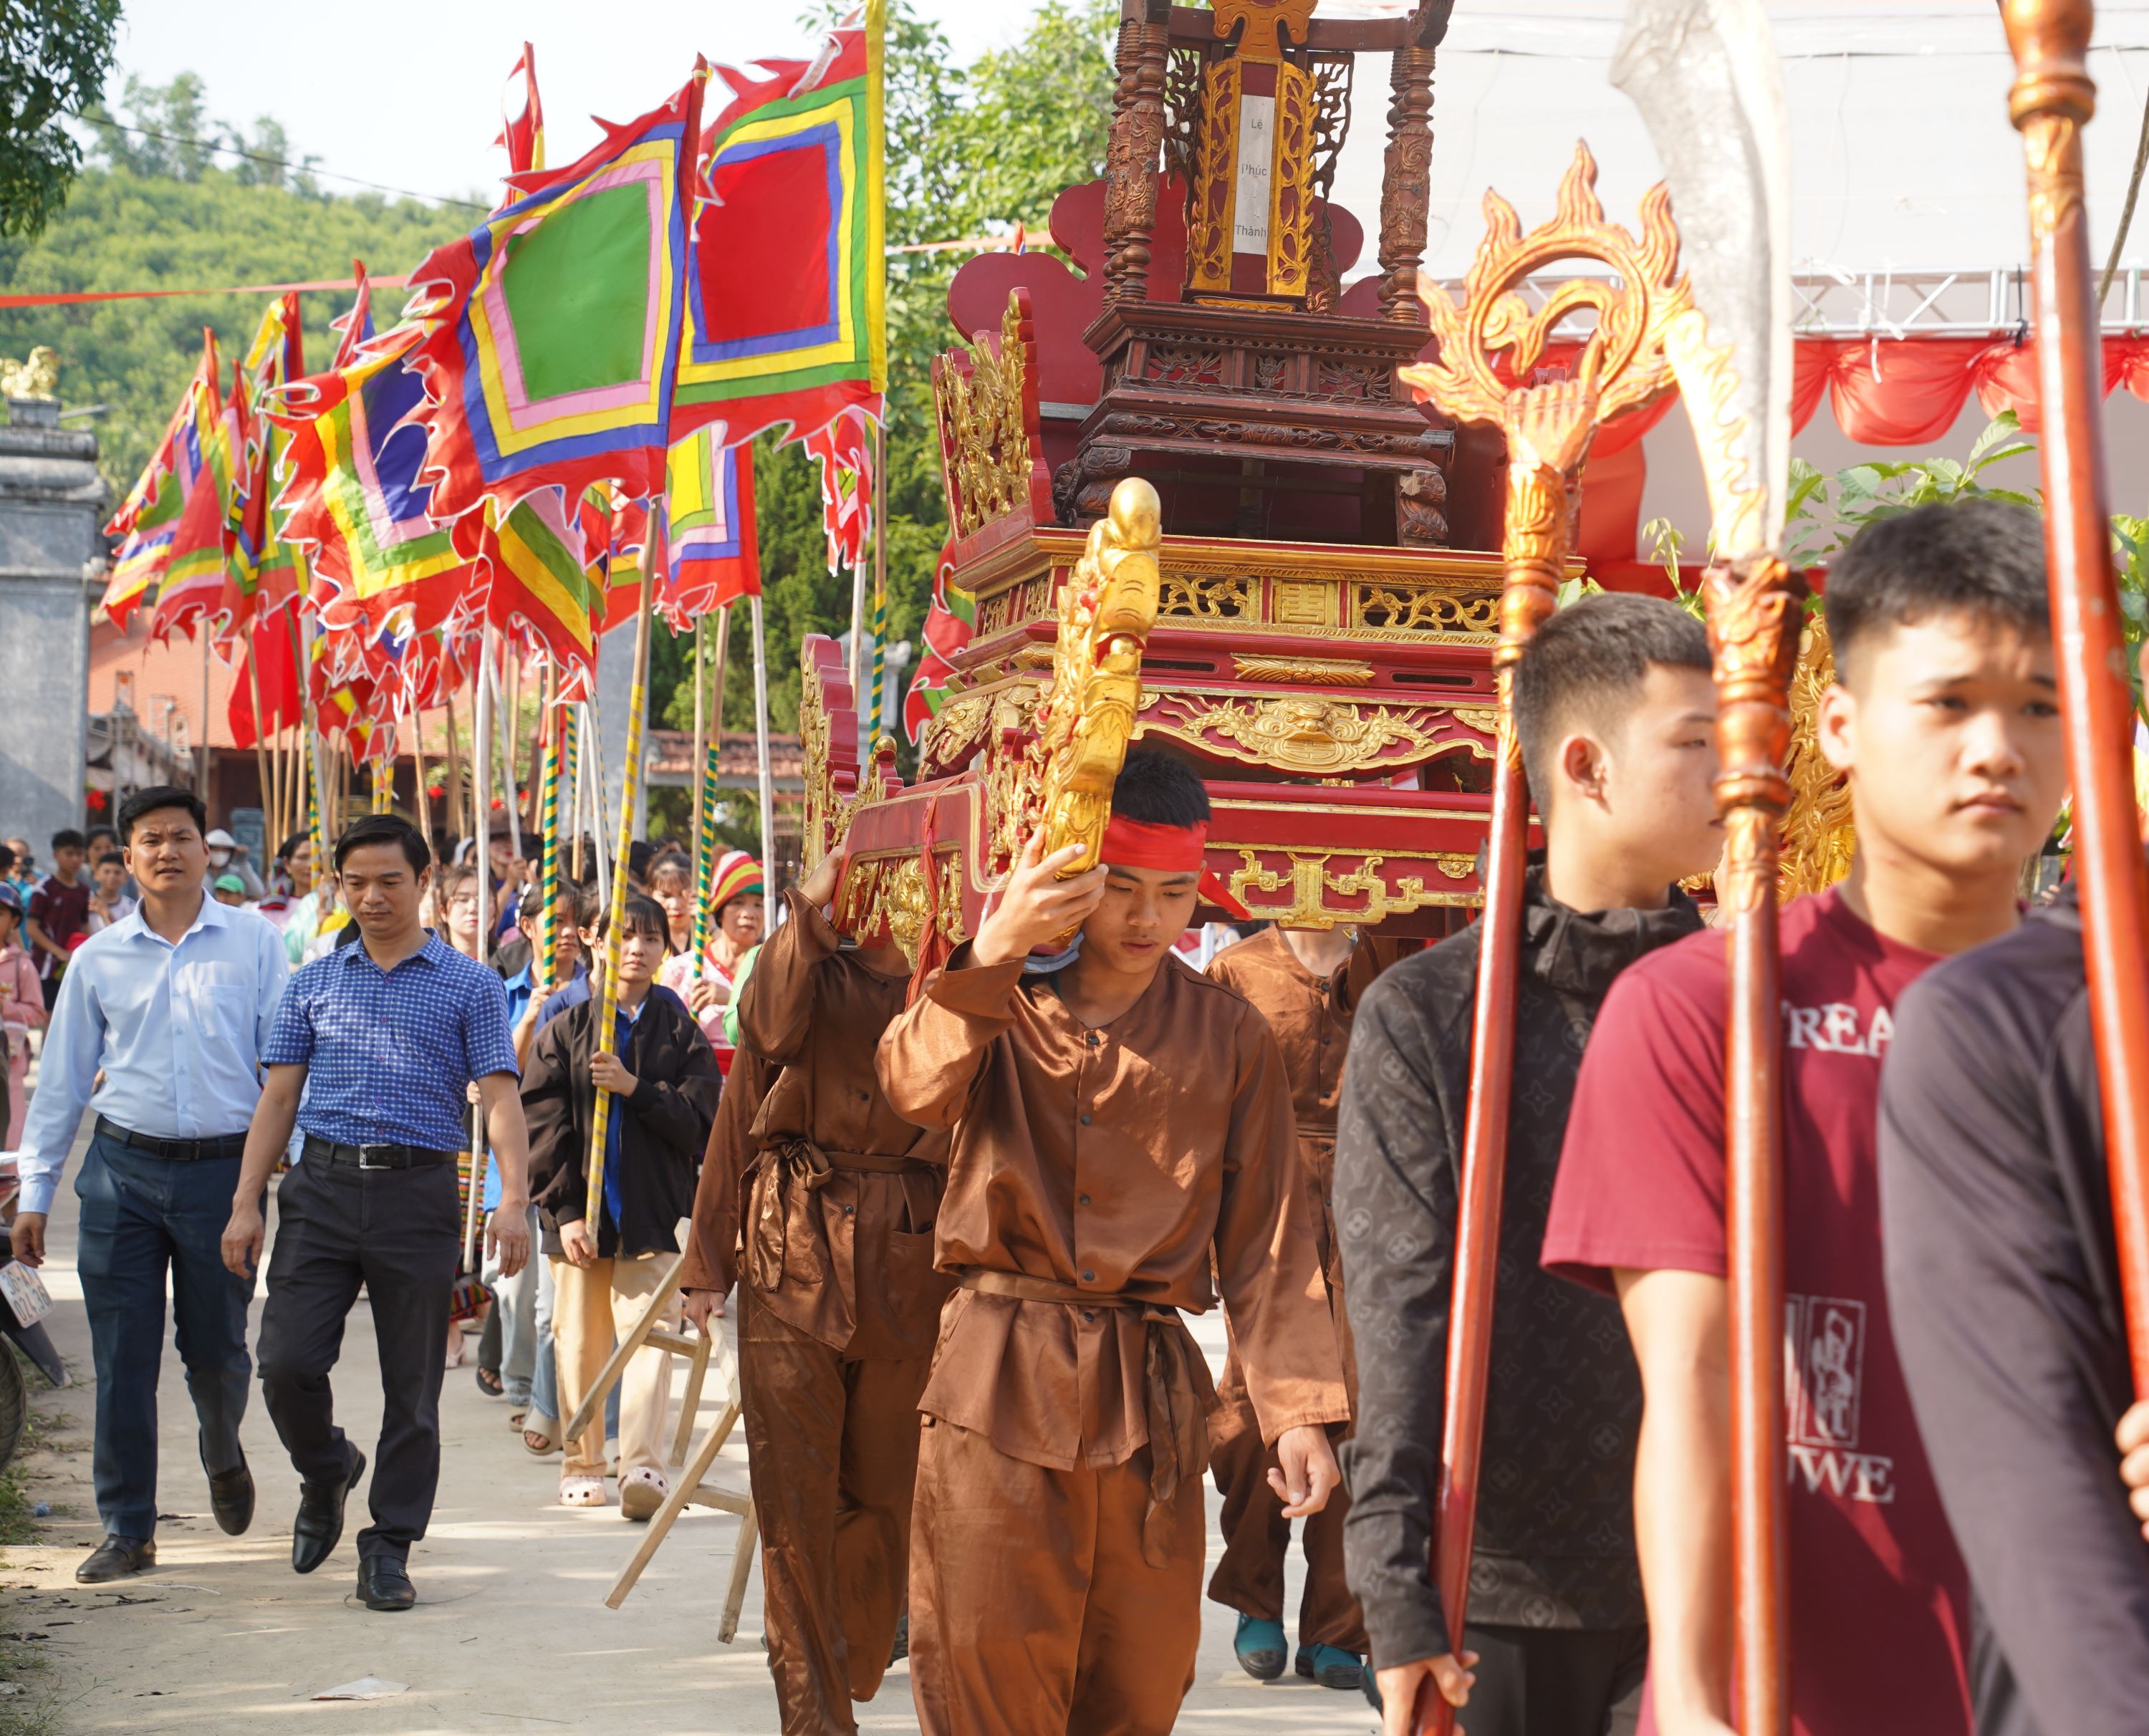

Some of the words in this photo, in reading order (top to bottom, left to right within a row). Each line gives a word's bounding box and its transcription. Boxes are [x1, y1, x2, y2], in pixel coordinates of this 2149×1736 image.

[1251, 118, 1264, 130] Lê
[1241, 163, 1267, 177] Phúc
[1235, 224, 1267, 238] Thành
